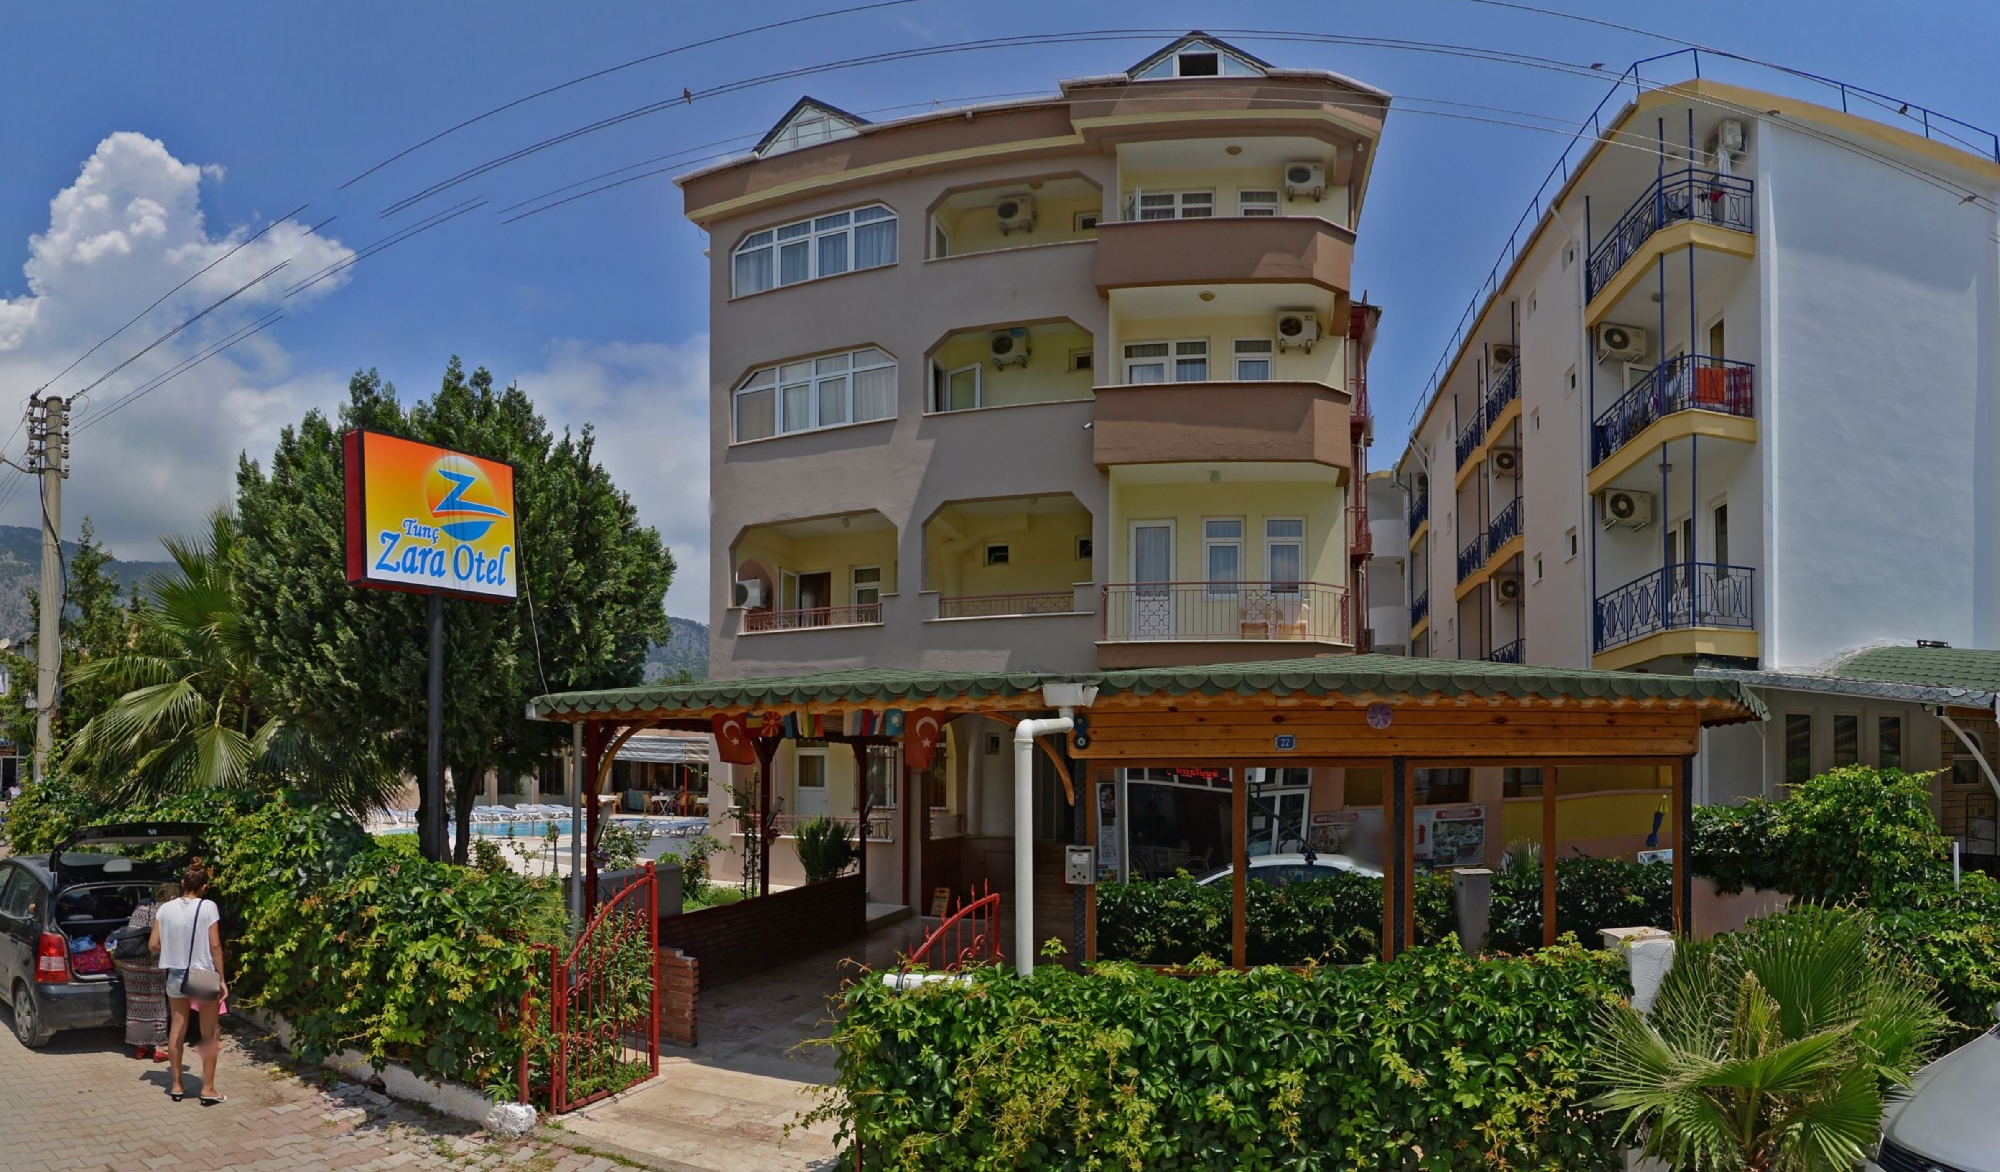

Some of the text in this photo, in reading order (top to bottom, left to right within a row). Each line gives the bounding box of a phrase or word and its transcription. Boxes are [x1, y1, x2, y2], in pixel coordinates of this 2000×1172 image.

[402, 518, 439, 544] Tunç
[375, 531, 511, 586] Zara Otel
[1280, 738, 1290, 747] 22
